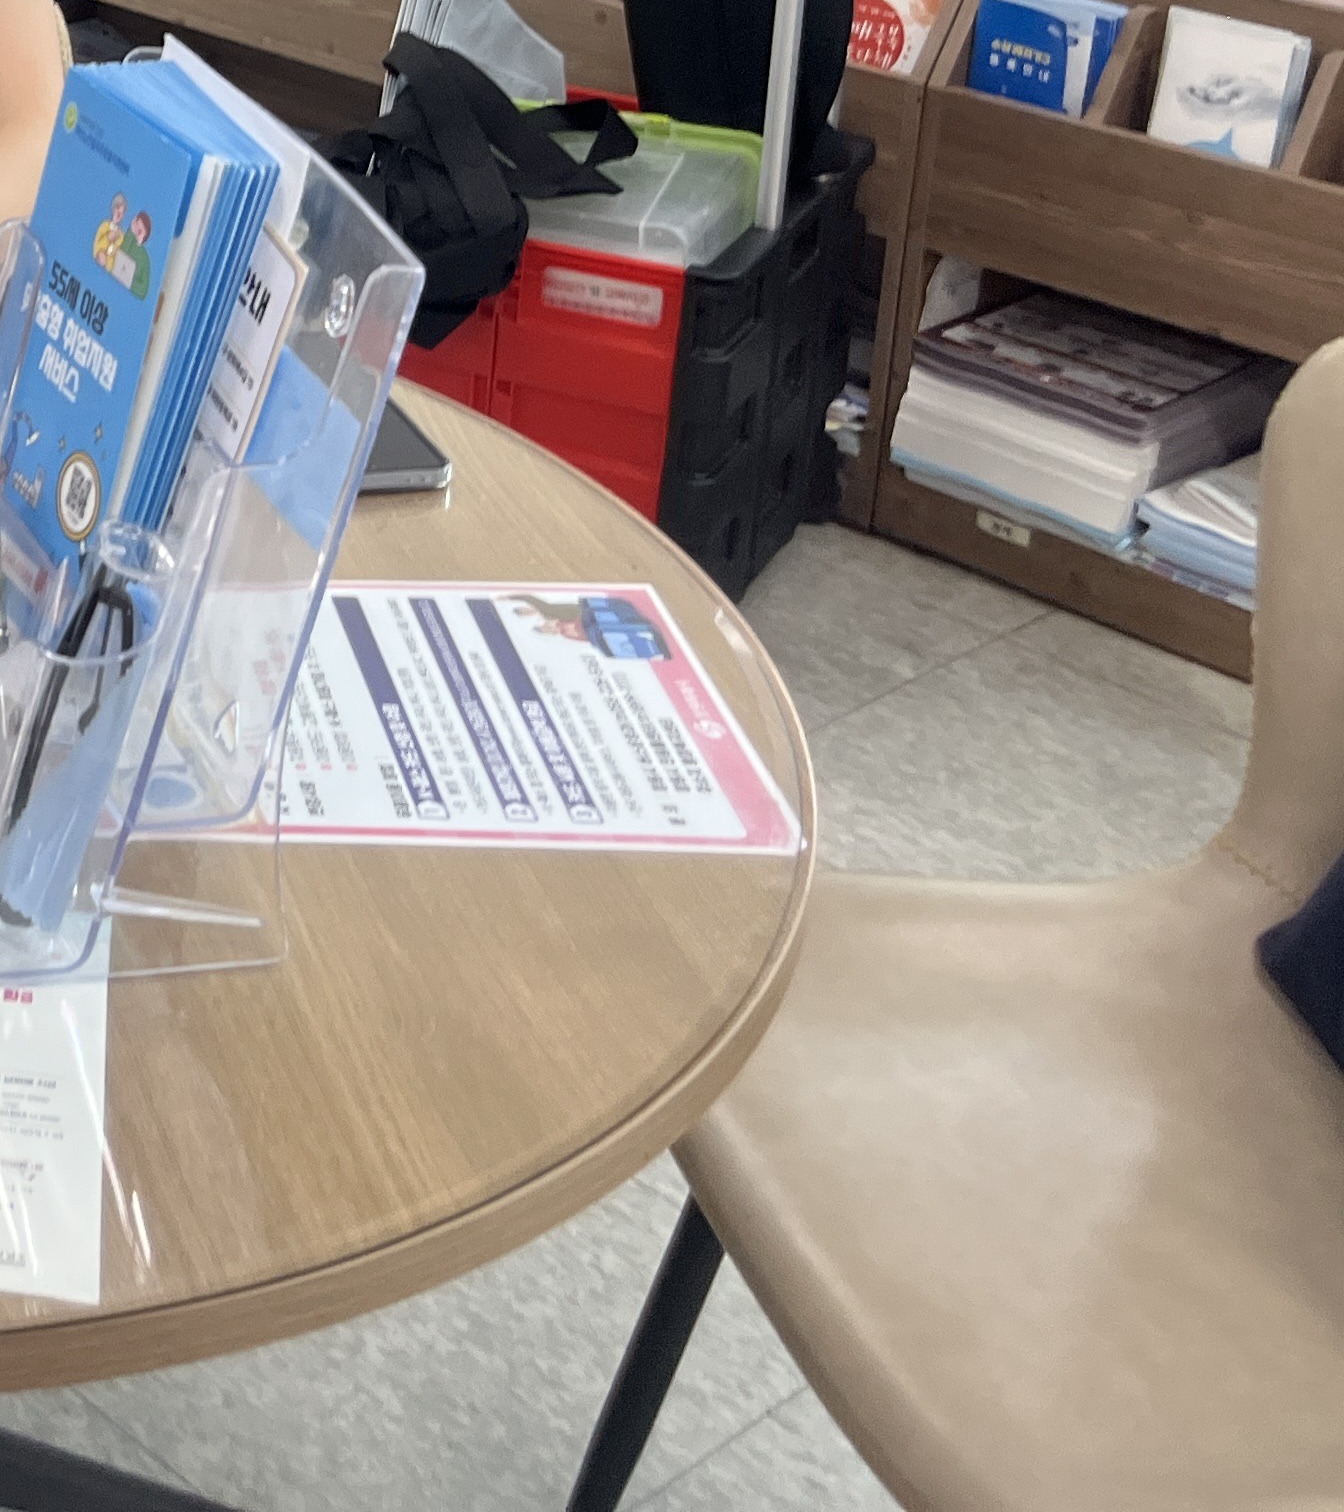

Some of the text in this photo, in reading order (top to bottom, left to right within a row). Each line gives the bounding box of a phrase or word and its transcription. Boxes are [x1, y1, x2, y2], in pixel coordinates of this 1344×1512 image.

[48, 259, 110, 337] 55세 이상
[38, 343, 80, 403] 서비스
[62, 318, 118, 392] 취업지원
